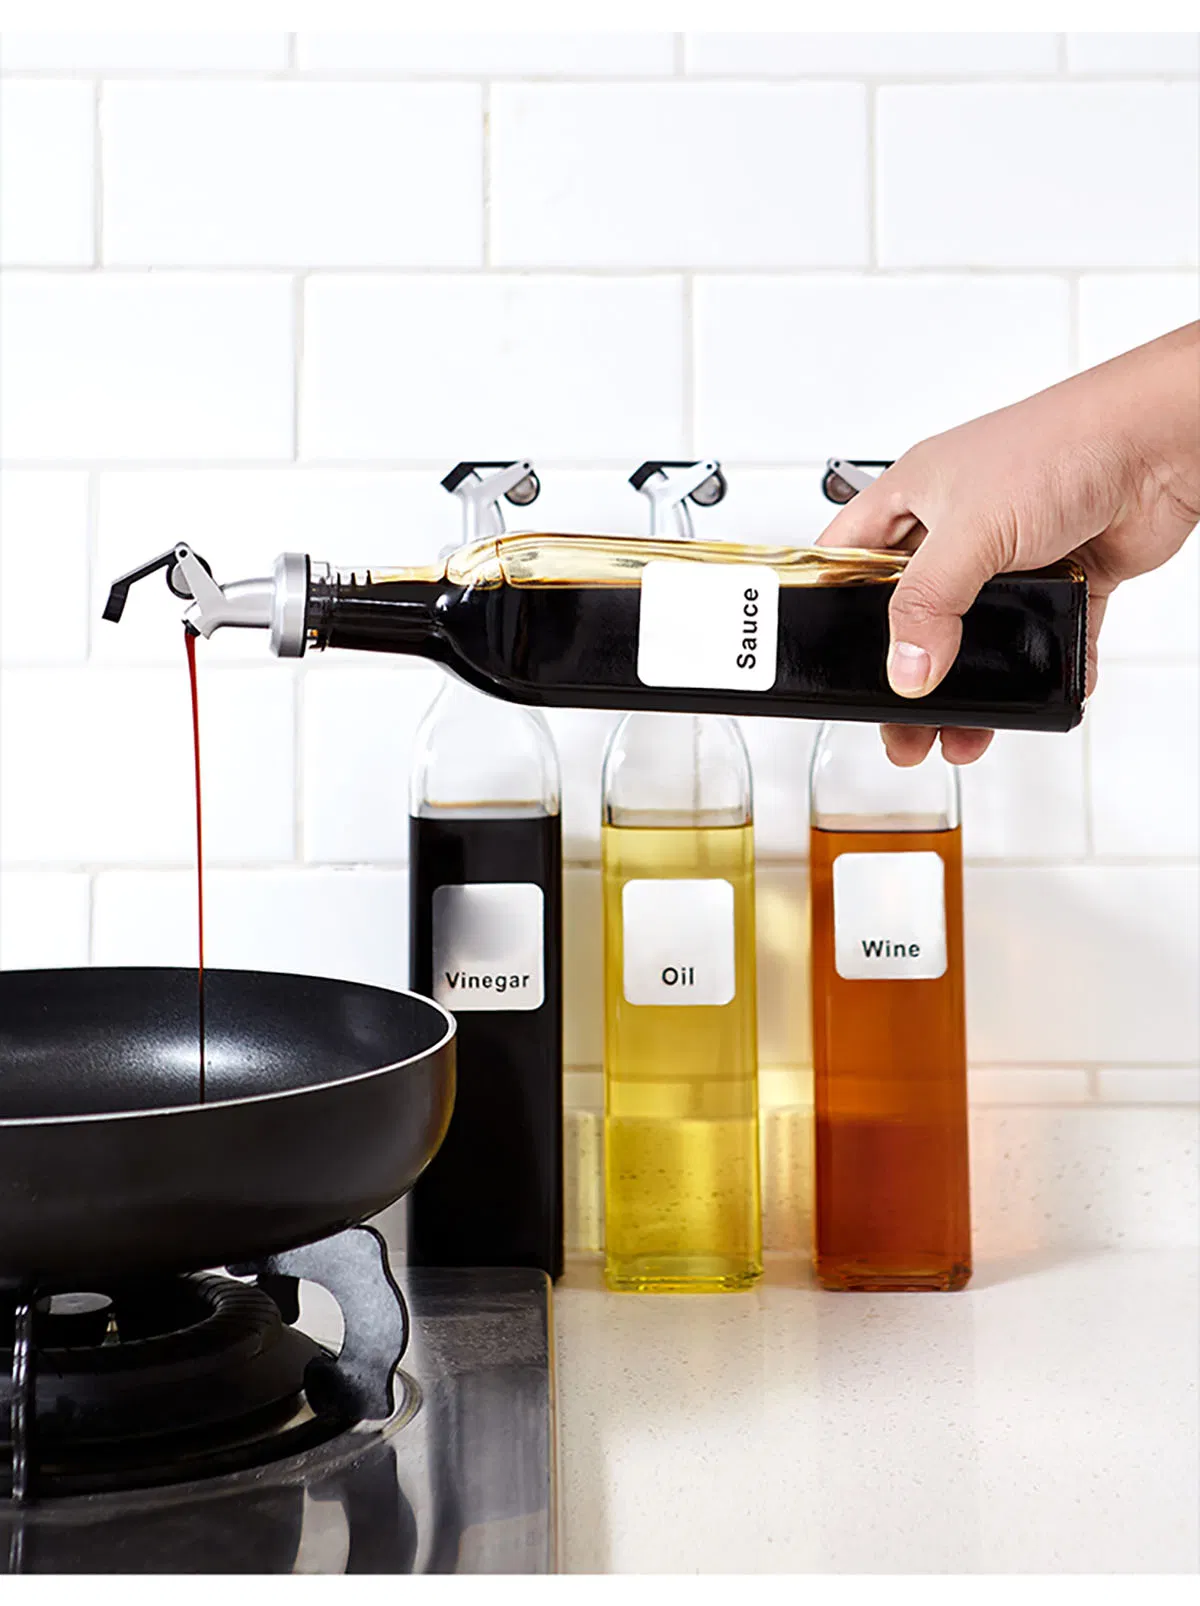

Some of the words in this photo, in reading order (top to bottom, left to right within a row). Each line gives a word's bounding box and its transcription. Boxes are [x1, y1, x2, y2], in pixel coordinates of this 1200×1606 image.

[736, 587, 759, 670] Sauce
[861, 939, 921, 958] Wine
[445, 970, 530, 993] Vinegar
[661, 966, 695, 986] Oil
